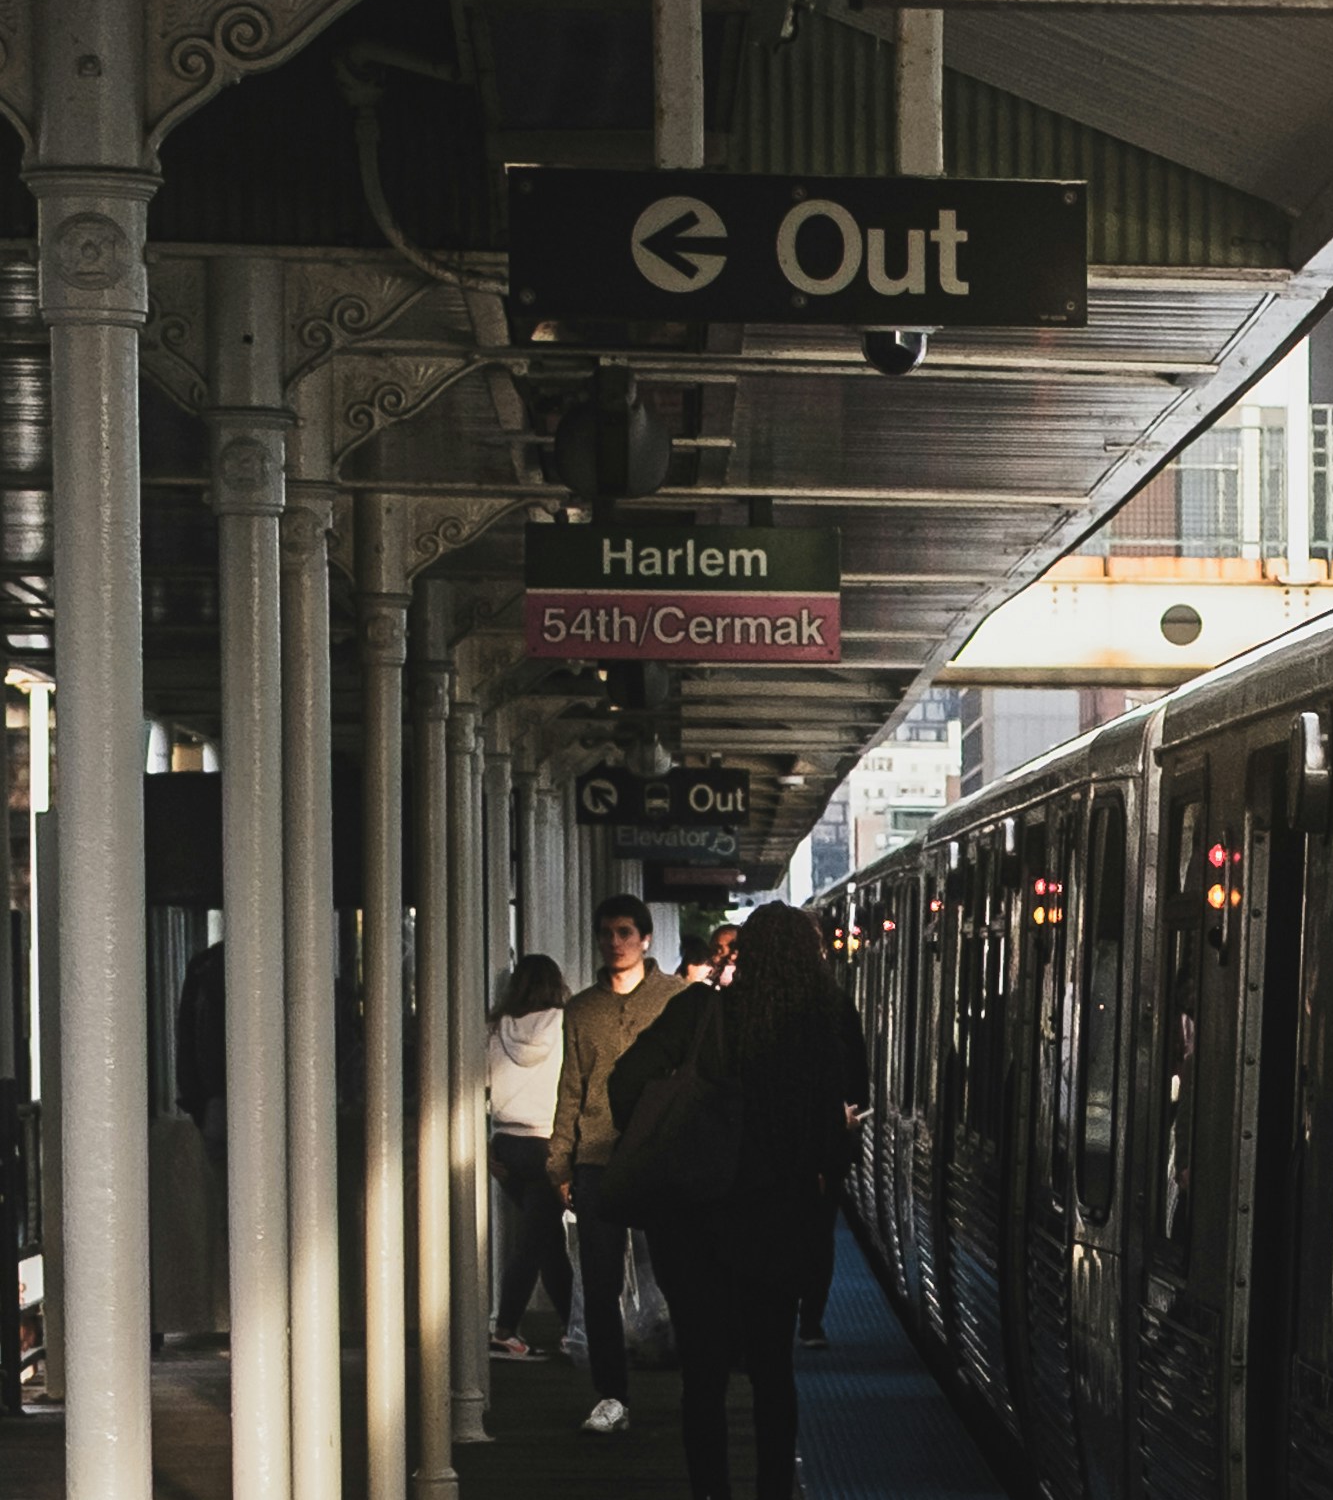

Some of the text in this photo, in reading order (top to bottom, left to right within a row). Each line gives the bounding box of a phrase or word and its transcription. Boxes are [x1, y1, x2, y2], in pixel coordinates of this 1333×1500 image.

[777, 199, 970, 296] Out
[601, 538, 768, 578] Harlem
[541, 606, 825, 646] 54th/Cermak
[689, 783, 746, 813] Out
[616, 824, 710, 847] Elevator
